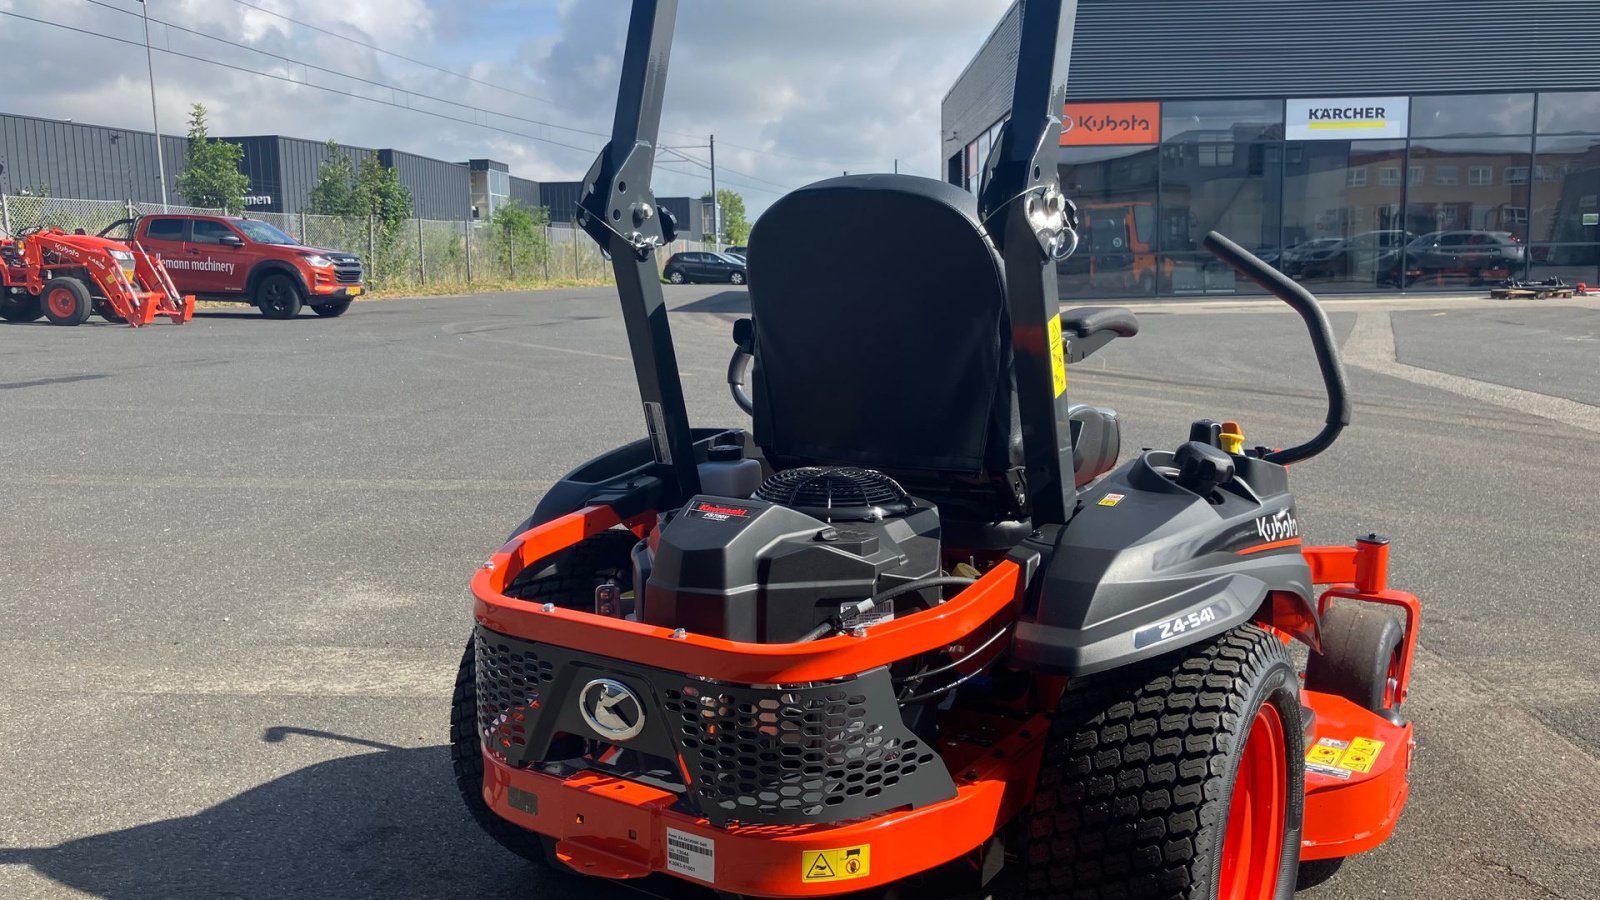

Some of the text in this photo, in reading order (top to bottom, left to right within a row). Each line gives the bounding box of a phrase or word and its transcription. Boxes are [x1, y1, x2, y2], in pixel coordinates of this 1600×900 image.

[1308, 107, 1386, 120] KÄRCHER
[1079, 114, 1150, 132] Kubota
[241, 195, 272, 206] men
[54, 243, 80, 258] Kubota
[191, 256, 235, 276] machinery
[1255, 512, 1298, 542] Kubota
[1158, 606, 1216, 640] Z4-541
